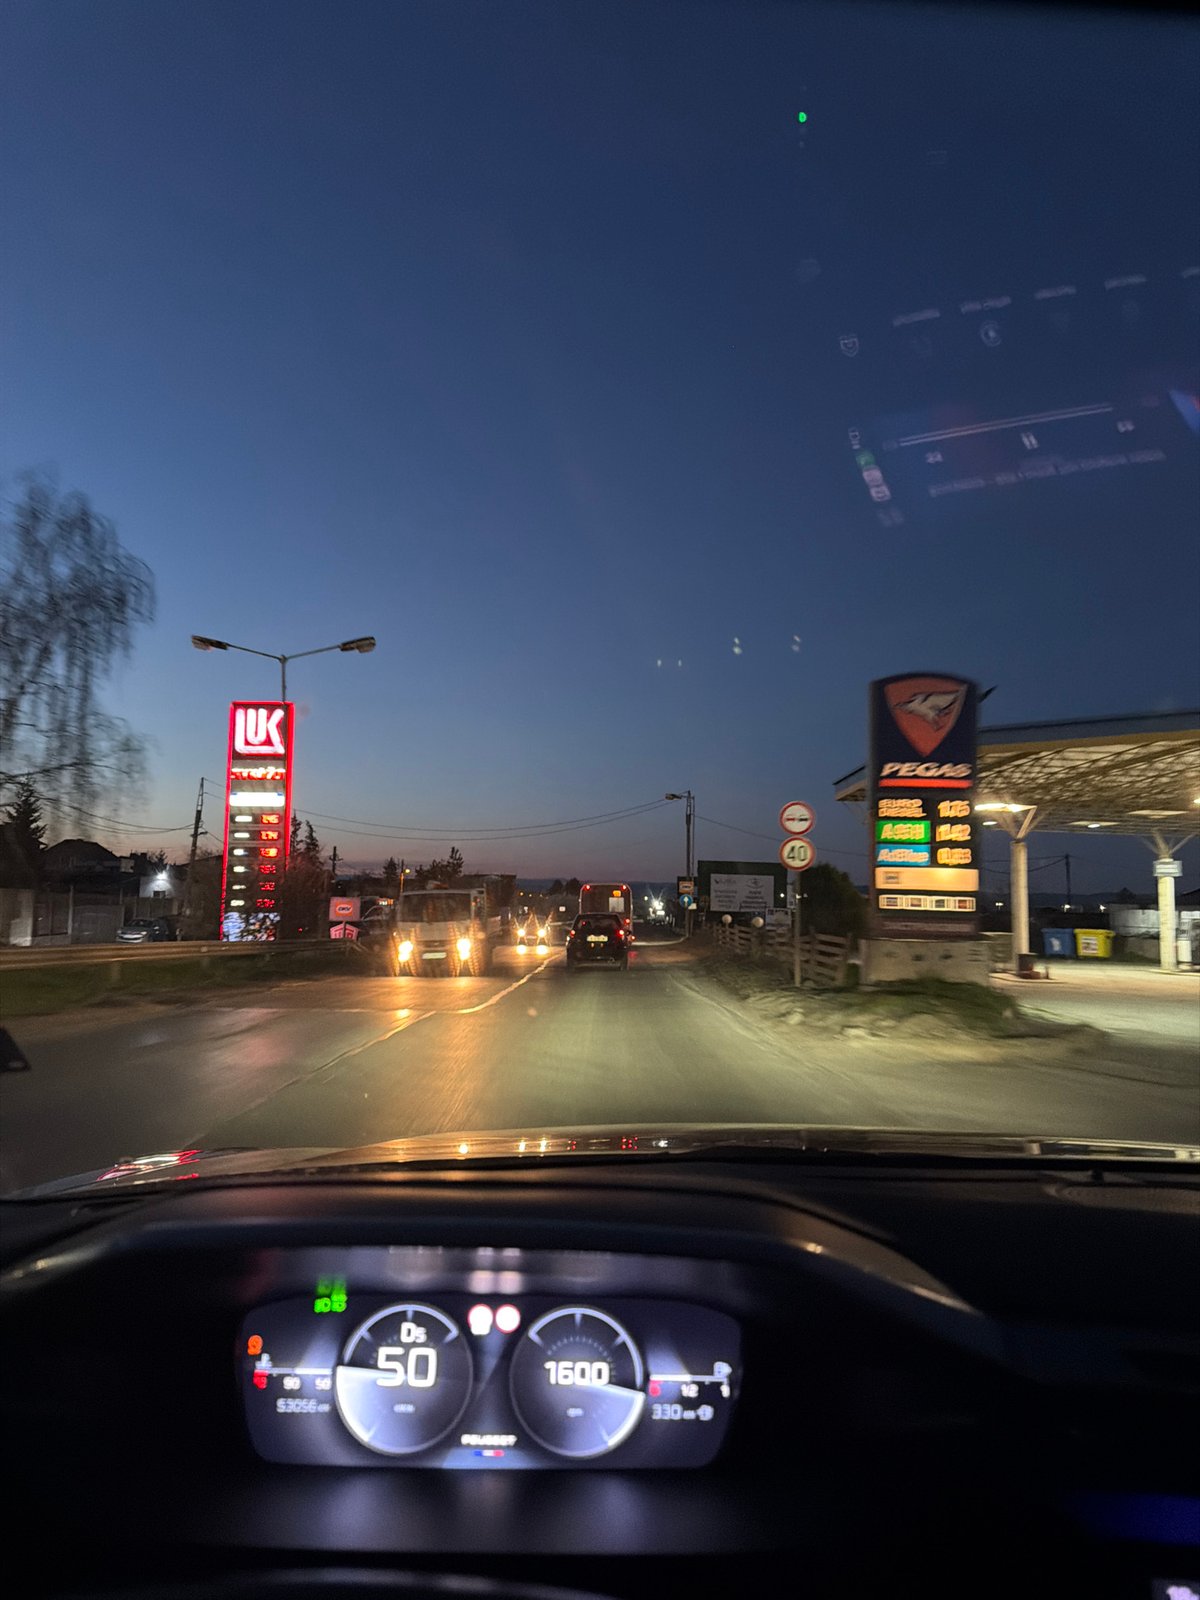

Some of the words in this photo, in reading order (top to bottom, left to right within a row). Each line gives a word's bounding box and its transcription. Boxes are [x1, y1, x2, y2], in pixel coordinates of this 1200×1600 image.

[880, 762, 973, 778] PEGAS
[787, 845, 809, 862] 40
[376, 1346, 438, 1387] 50
[544, 1360, 610, 1386] 1600
